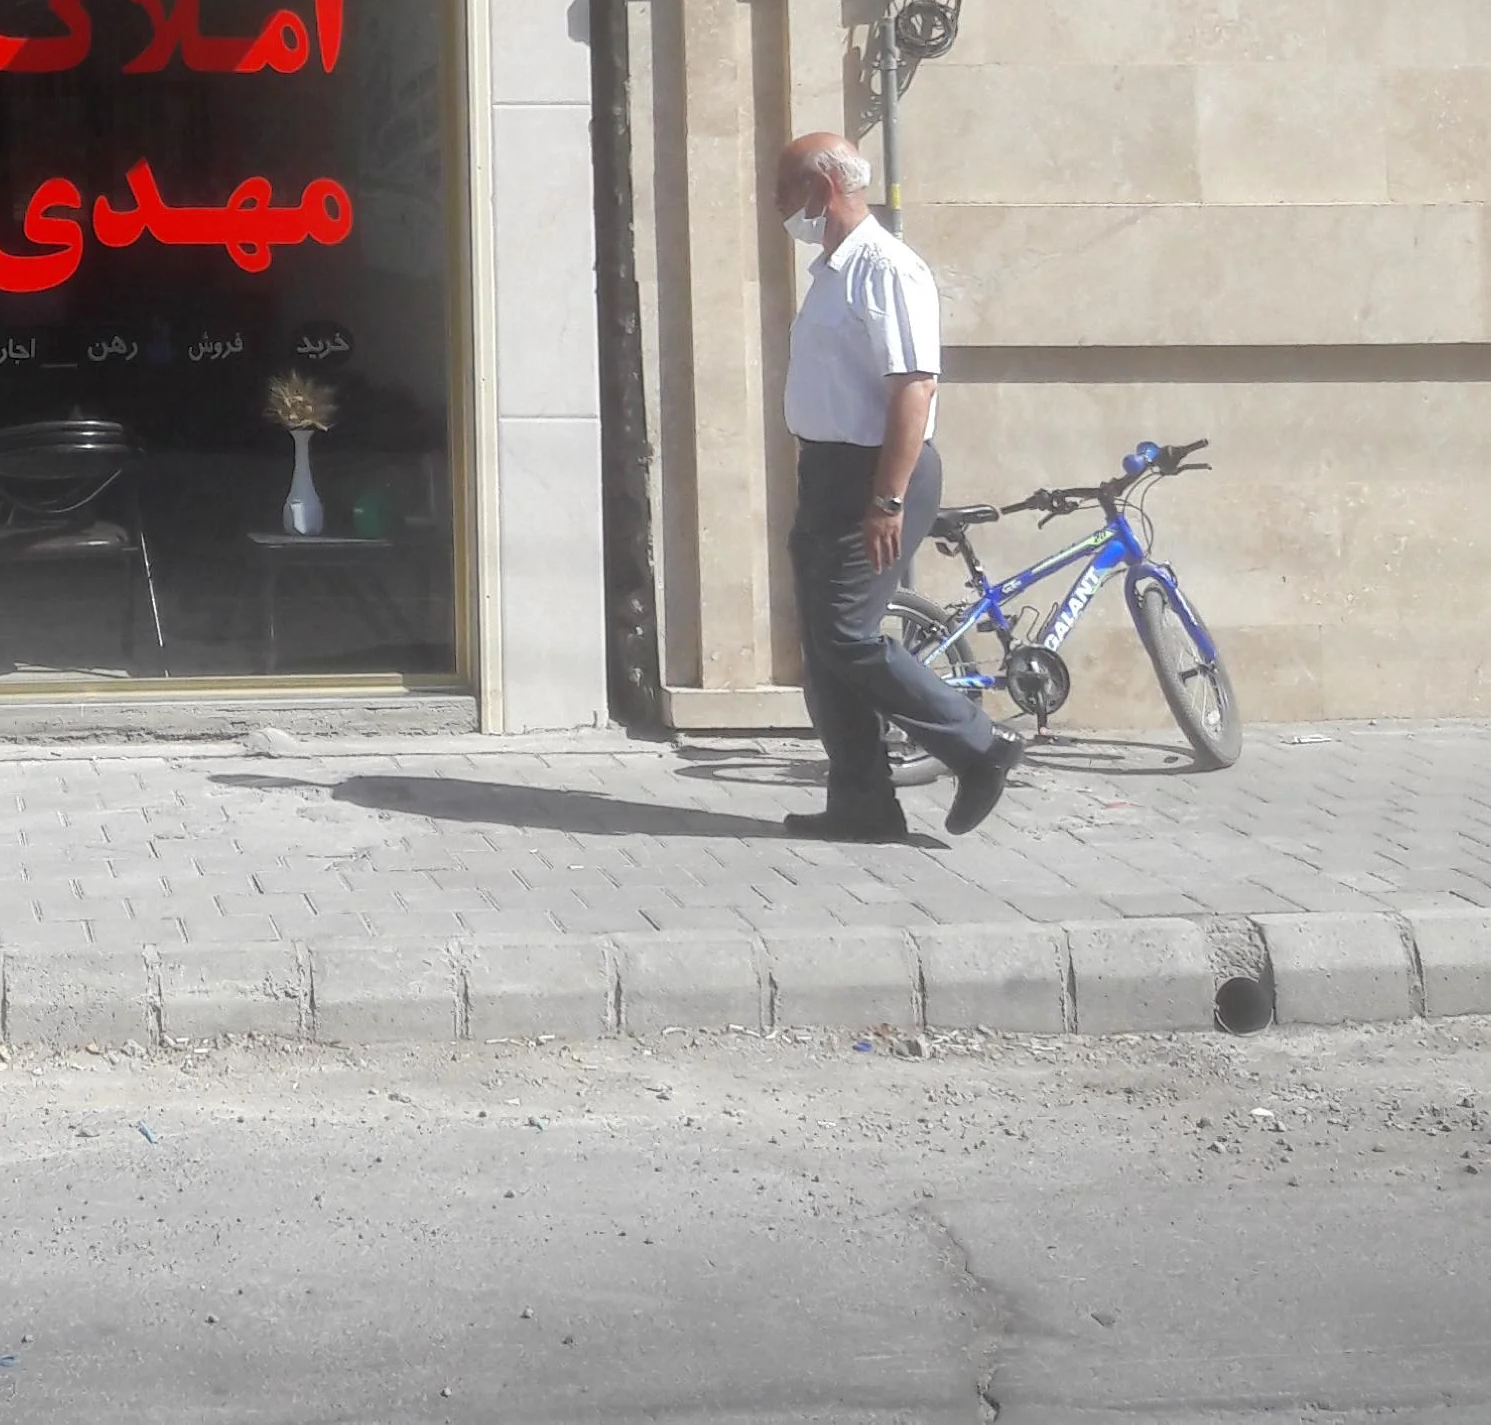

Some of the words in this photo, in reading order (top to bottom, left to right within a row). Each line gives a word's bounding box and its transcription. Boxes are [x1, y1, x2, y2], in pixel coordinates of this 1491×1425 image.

[87, 334, 139, 361] رهن
[187, 331, 244, 361] فروش
[296, 332, 350, 358] خرید
[1044, 566, 1099, 652] GALANT
